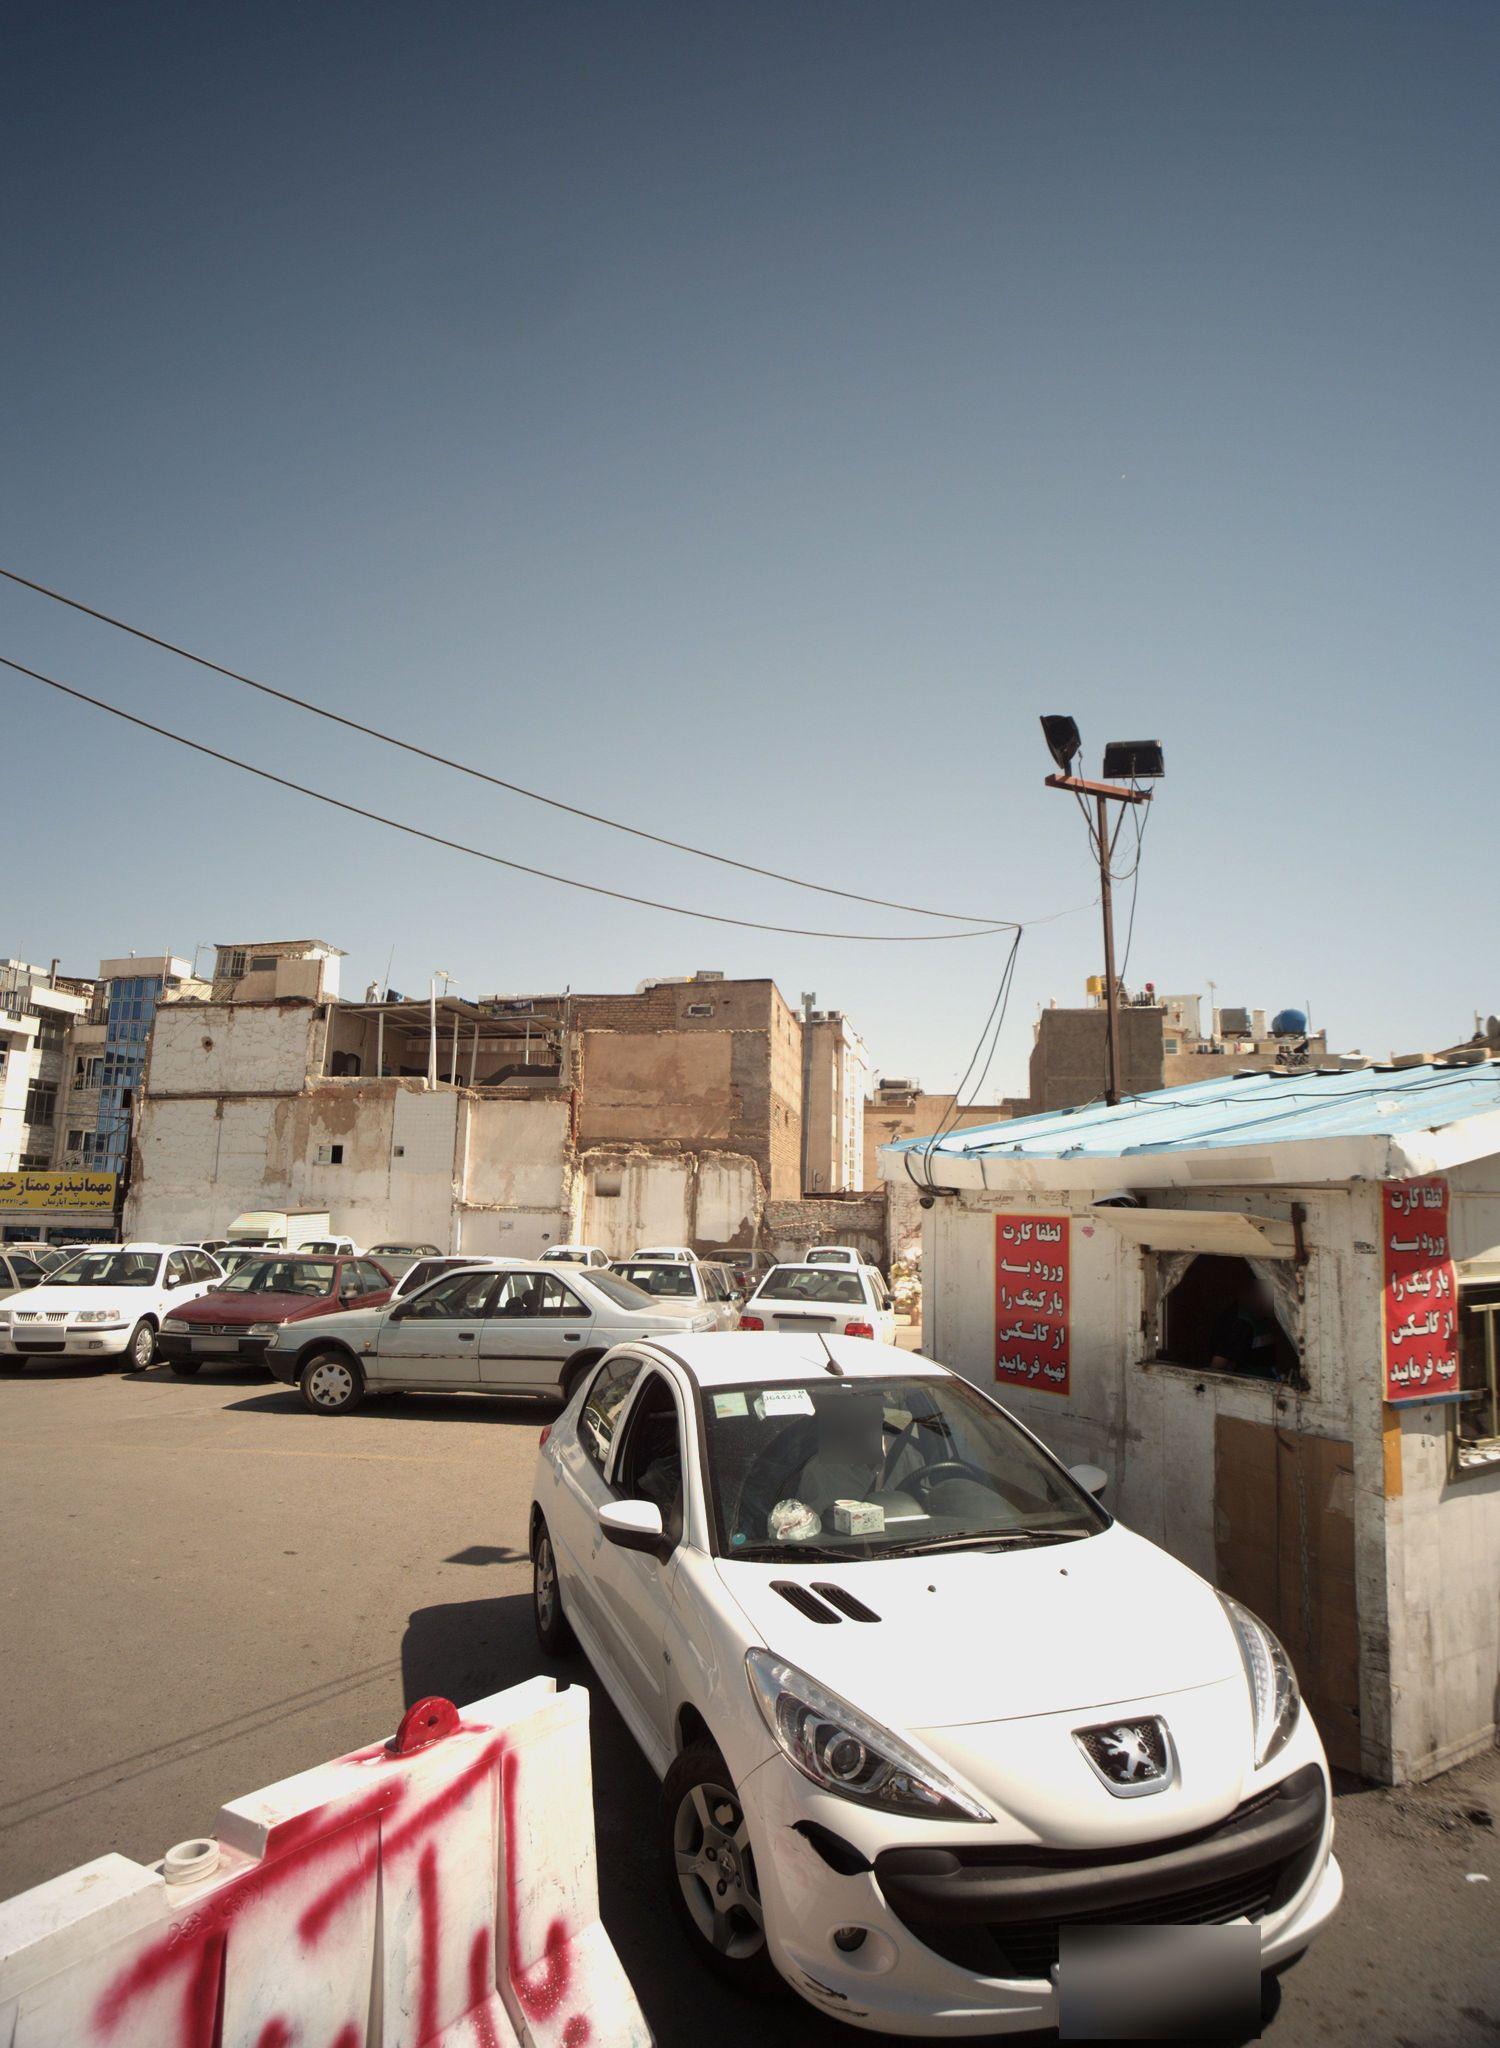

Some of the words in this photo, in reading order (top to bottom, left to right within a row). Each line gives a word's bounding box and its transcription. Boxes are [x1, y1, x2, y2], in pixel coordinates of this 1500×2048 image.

[16, 1176, 49, 1196] ممتاز
[1422, 1185, 1443, 1211] لطفا
[1391, 1186, 1420, 1215] کارت
[1002, 1222, 1033, 1245] کارت
[1035, 1222, 1062, 1242] لطفا
[1390, 1232, 1420, 1255] به
[1421, 1231, 1446, 1257] ورود
[1000, 1257, 1031, 1278] به
[1033, 1260, 1064, 1282] ورود
[1391, 1271, 1404, 1302] را
[1406, 1267, 1449, 1299] پارکینگ
[1001, 1286, 1013, 1309] را
[1015, 1288, 1063, 1317] پارکینگ
[1000, 1319, 1049, 1342] کانکس
[1391, 1309, 1440, 1345] کانکس
[1443, 1308, 1454, 1339] از
[1052, 1326, 1065, 1350] از
[998, 1353, 1041, 1380] فرمایید
[1043, 1361, 1067, 1383] تهیه
[1390, 1351, 1433, 1386] فرمایید
[1435, 1350, 1457, 1380] تهیه
